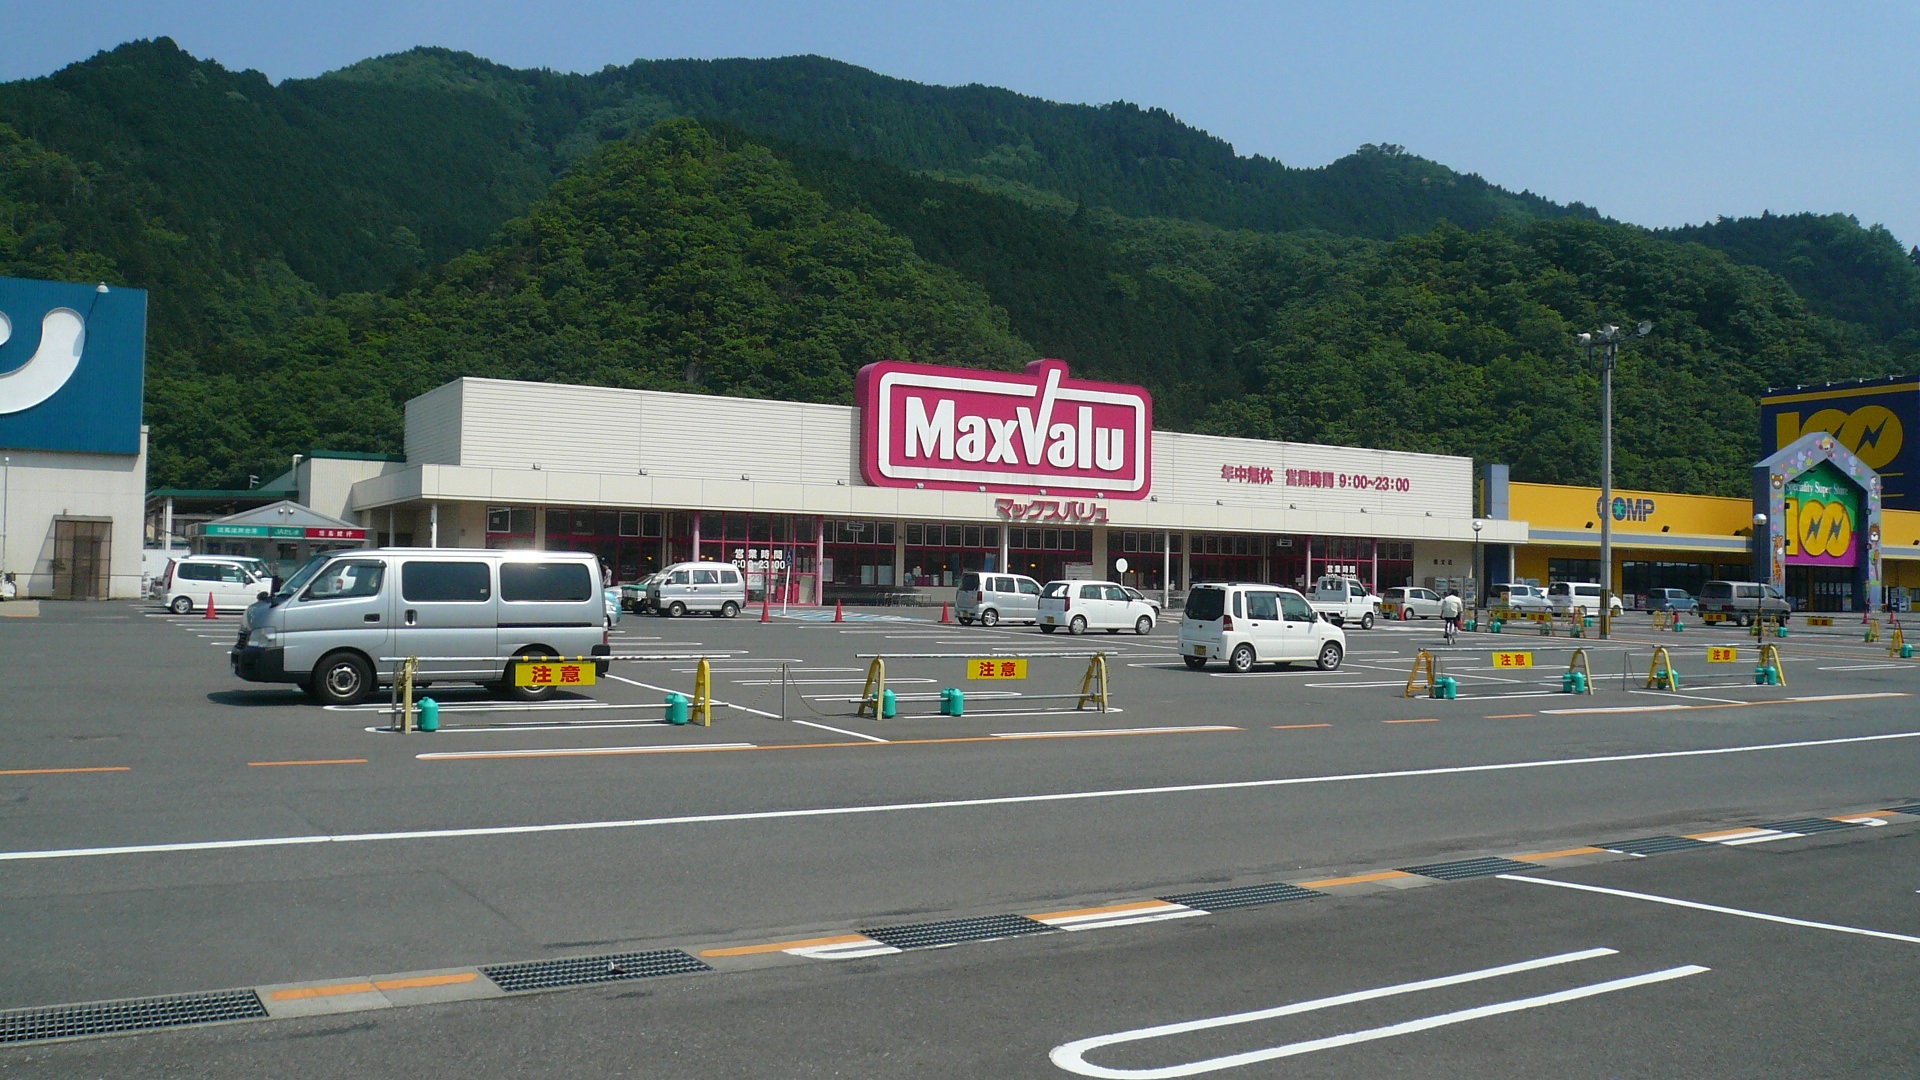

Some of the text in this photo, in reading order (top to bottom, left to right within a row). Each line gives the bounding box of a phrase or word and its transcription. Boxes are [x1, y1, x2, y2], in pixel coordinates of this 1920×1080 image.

[905, 369, 1124, 471] MaxValu
[1221, 465, 1273, 485] 年中無休
[1286, 469, 1334, 488] 営業時間
[1814, 481, 1832, 497] Super
[1833, 483, 1849, 496] Store
[995, 498, 1109, 522] マックスバリュ
[1786, 498, 1851, 557] 100
[734, 548, 783, 560] 営業時間
[1500, 654, 1525, 666] 注意
[1713, 650, 1730, 660] 注意
[531, 665, 581, 683] 注意
[979, 661, 1016, 677] 注意
